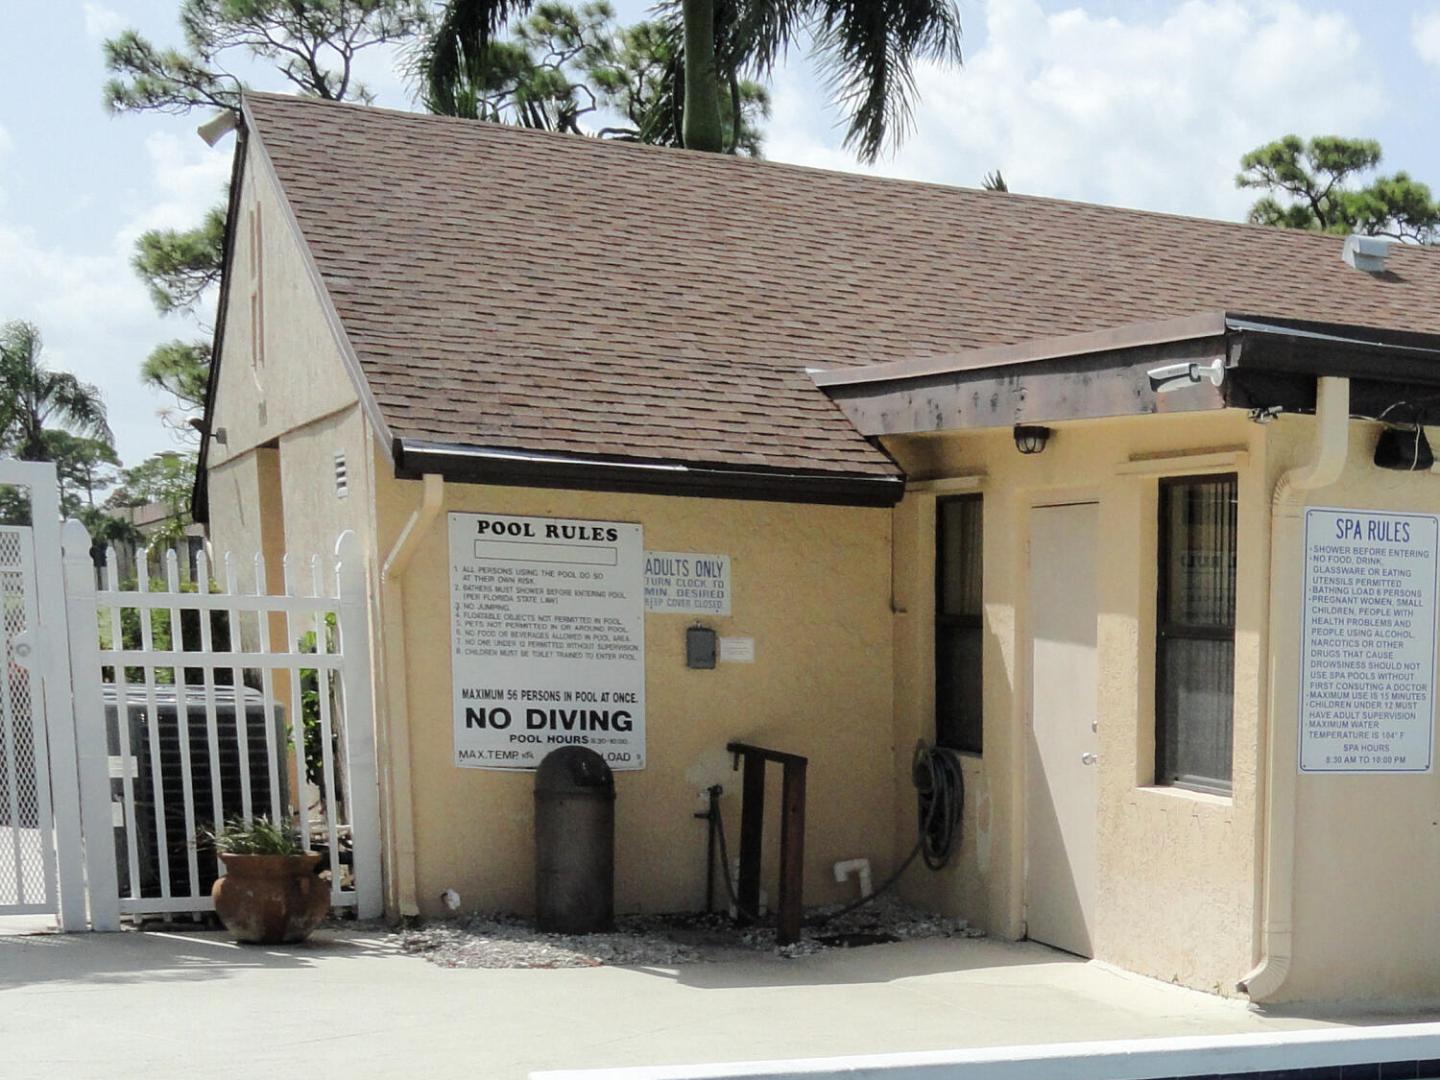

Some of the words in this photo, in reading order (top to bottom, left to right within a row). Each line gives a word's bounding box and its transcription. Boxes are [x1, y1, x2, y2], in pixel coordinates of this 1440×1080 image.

[477, 520, 534, 537] POOL
[545, 524, 618, 542] RULES
[1335, 518, 1362, 540] SPA
[1368, 519, 1409, 542] RULES
[1313, 545, 1350, 554] SHOWER
[1353, 546, 1386, 556] BEFORE
[1388, 548, 1429, 558] ENTERING
[462, 564, 473, 572] ALL
[478, 565, 512, 574] PERSONS
[515, 567, 537, 576] USING
[541, 569, 554, 577] THE
[557, 570, 576, 578] POOL
[579, 571, 590, 579] DO
[645, 558, 689, 576] ADULTS
[696, 560, 723, 578] ONLY
[1313, 565, 1365, 575] GLASSWARE
[1382, 568, 1411, 577] EATING
[462, 573, 470, 581] AT
[474, 574, 494, 582] THEIR
[497, 575, 514, 583] OWN
[644, 577, 671, 586] TURN
[676, 578, 707, 588] CLOCK
[713, 580, 724, 588] TO
[1312, 577, 1353, 585] UTENSILS
[1355, 578, 1401, 587] PERMITTED
[463, 583, 492, 592] BATHERS
[495, 585, 512, 593] MUST
[515, 586, 543, 594] SHOWER
[546, 588, 571, 596] BEFORE
[574, 589, 606, 598] ENTERING
[677, 589, 724, 598] DESIRED
[1312, 586, 1348, 594] BATHING
[1351, 587, 1374, 595] LOAD
[1383, 588, 1421, 597] PERSONS
[483, 593, 513, 601] FLORIDA
[516, 595, 536, 603] STATE
[667, 598, 691, 608] COVER
[1312, 595, 1358, 604] PREGNANT
[1396, 598, 1423, 606] SMALL
[1359, 607, 1390, 616] PEOPLE
[1393, 608, 1413, 616] WITH
[463, 610, 500, 619] FLOATABLE
[503, 612, 535, 621] OBJECTS
[537, 614, 551, 622] NOT
[554, 615, 592, 624] PERMITTED
[1311, 617, 1344, 625] HEALTH
[1347, 618, 1392, 626] PROBLEMS
[1393, 619, 1411, 627] AND
[464, 619, 483, 627] PETS
[487, 620, 501, 628] NOT
[505, 621, 547, 630] PERMITTED
[574, 625, 604, 633] AROUND
[1311, 628, 1344, 636] PEOPLE
[1346, 629, 1372, 637] USING
[1311, 639, 1359, 647] NARCOTICS
[1375, 640, 1403, 648] OTHER
[464, 647, 497, 655] CHILDREN
[499, 648, 517, 656] MUST
[585, 652, 593, 660] TO
[595, 653, 616, 661] ENTER
[1311, 649, 1340, 657] DRUGS
[1343, 650, 1362, 658] THAT
[1310, 660, 1366, 669] DROWSINESS
[1369, 661, 1401, 669] SHOULD
[1403, 662, 1420, 670] NOT
[1329, 671, 1345, 679] SPA
[1377, 672, 1415, 680] WITHOUT
[1310, 681, 1332, 689] FIRST
[462, 687, 503, 700] MAXIMUM
[507, 688, 517, 700] 56
[520, 689, 560, 701] PERSONS
[563, 690, 572, 701] IN
[575, 690, 597, 702] POOL
[600, 691, 610, 703] AT
[612, 691, 638, 703] ONCE.
[1309, 691, 1349, 699] MAXIMUM
[1351, 691, 1368, 699] USE
[1391, 692, 1426, 700] MINUTES
[1309, 700, 1351, 708] CHILDREN
[1395, 701, 1417, 709] MUST
[465, 705, 511, 729] NO
[526, 707, 632, 732] DIVING
[1333, 711, 1359, 719] ADULT
[1350, 720, 1379, 728] WATER
[509, 733, 543, 743] POOL
[546, 734, 589, 744] HOURS
[1399, 731, 1404, 739] F
